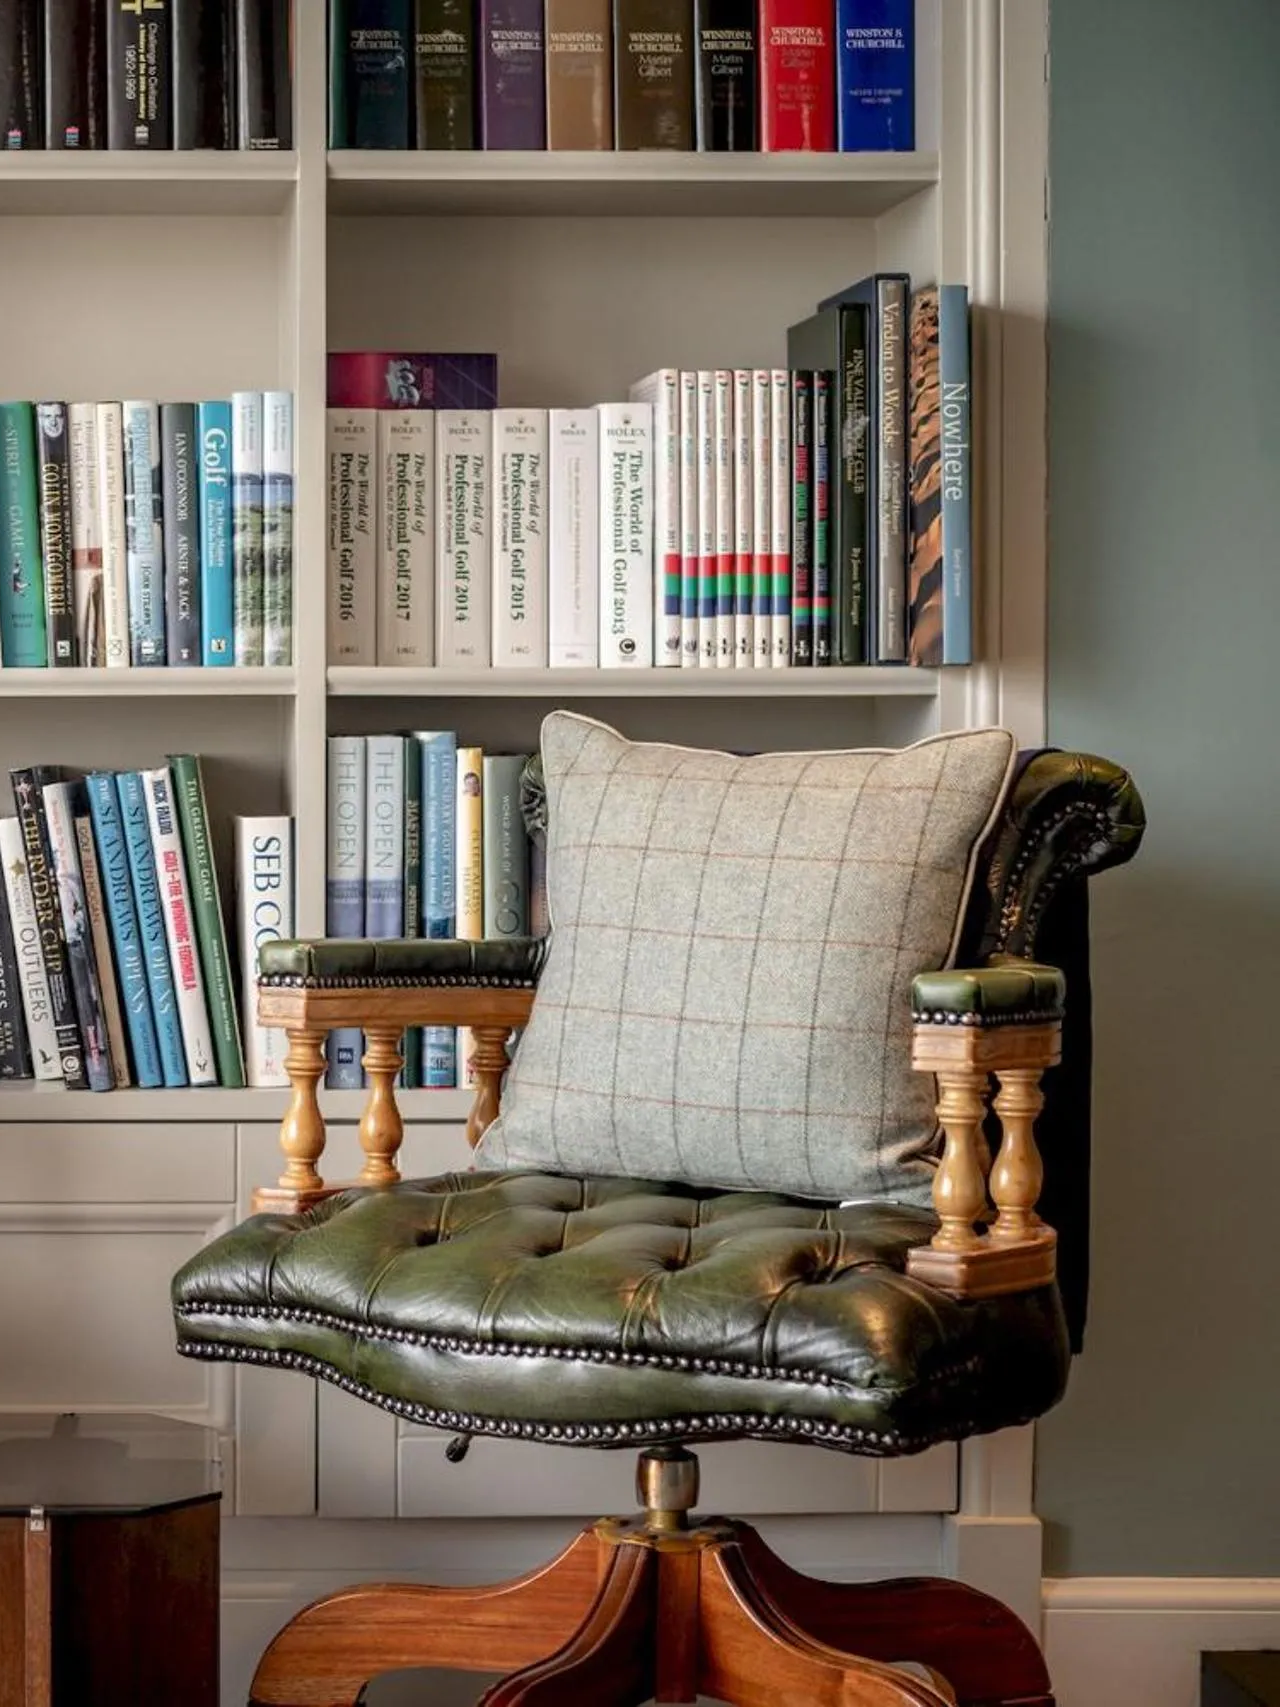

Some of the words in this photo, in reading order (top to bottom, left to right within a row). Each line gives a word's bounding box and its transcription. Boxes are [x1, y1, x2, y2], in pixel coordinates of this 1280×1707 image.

[549, 43, 604, 52] CHURCHILL
[628, 43, 683, 52] CHURCHILL
[702, 41, 753, 50] CHURCHILL
[770, 37, 825, 46] CHURCHILL
[846, 28, 889, 38] WINSTON
[846, 40, 904, 48] CHURCHILL
[712, 54, 743, 63] Martin
[712, 65, 743, 75] Gilbert
[883, 303, 899, 360] Vardon
[853, 350, 864, 377] PINE
[884, 366, 898, 383] to
[883, 389, 900, 448] Woods:
[6, 429, 21, 478] SPIRIT
[175, 432, 188, 454] IAN
[204, 427, 228, 487] Golf
[942, 382, 967, 501] Nowhere
[358, 453, 369, 473] The
[415, 453, 426, 473] The
[473, 455, 484, 475] The
[529, 453, 540, 473] The
[630, 451, 642, 481] The
[42, 463, 61, 507] COLIN
[176, 458, 189, 521] O'CONNOR
[340, 453, 354, 542] Professional
[358, 480, 369, 514] World
[396, 453, 410, 542] Professional
[415, 480, 426, 514] World
[455, 455, 469, 544] Professional
[473, 482, 484, 516] World
[511, 453, 525, 542] Professional
[529, 480, 540, 514] World
[611, 451, 626, 553] Professional
[217, 499, 225, 516] The
[630, 487, 643, 528] World
[356, 520, 370, 534] of
[413, 520, 427, 534] of
[471, 522, 485, 536] of
[527, 520, 541, 535] of
[45, 511, 66, 615] MONTGOMERIE
[178, 534, 189, 571] ARNIE
[339, 549, 354, 579] Golf
[396, 549, 410, 579] Golf
[511, 549, 525, 579] Golf
[630, 538, 643, 556] of
[178, 576, 189, 586] &
[455, 551, 469, 581] Golf
[612, 558, 627, 592] Golf
[177, 589, 190, 622] JACK
[339, 584, 354, 620] 2016
[396, 583, 410, 620] 2017
[455, 586, 469, 622] 2014
[511, 584, 525, 620] 2015
[610, 597, 626, 634] 2013
[336, 747, 356, 791] THE
[373, 747, 394, 791] THE
[151, 779, 169, 805] NICK
[186, 777, 199, 797] THE
[442, 754, 453, 822] LEGENDARY
[23, 814, 39, 850] THE
[102, 806, 116, 828] ST
[129, 806, 143, 828] ST
[158, 806, 174, 836] FALDO
[408, 800, 419, 866] MASTERS
[190, 806, 207, 867] GREATEST
[335, 800, 356, 869] OPEN
[373, 800, 394, 869] OPEN
[443, 829, 453, 860] GOLF
[253, 836, 281, 893] SEB
[27, 852, 54, 923] RYDER
[105, 835, 133, 942] ANDREWS
[132, 835, 160, 942] ANDREWS
[200, 869, 213, 903] GAME
[170, 900, 191, 943] WINNING
[40, 929, 64, 972] CUP
[19, 927, 50, 1023] OUTLIERS
[123, 945, 144, 1013] OPENS
[150, 945, 171, 1013] OPENS
[177, 945, 199, 992] FORMULA
